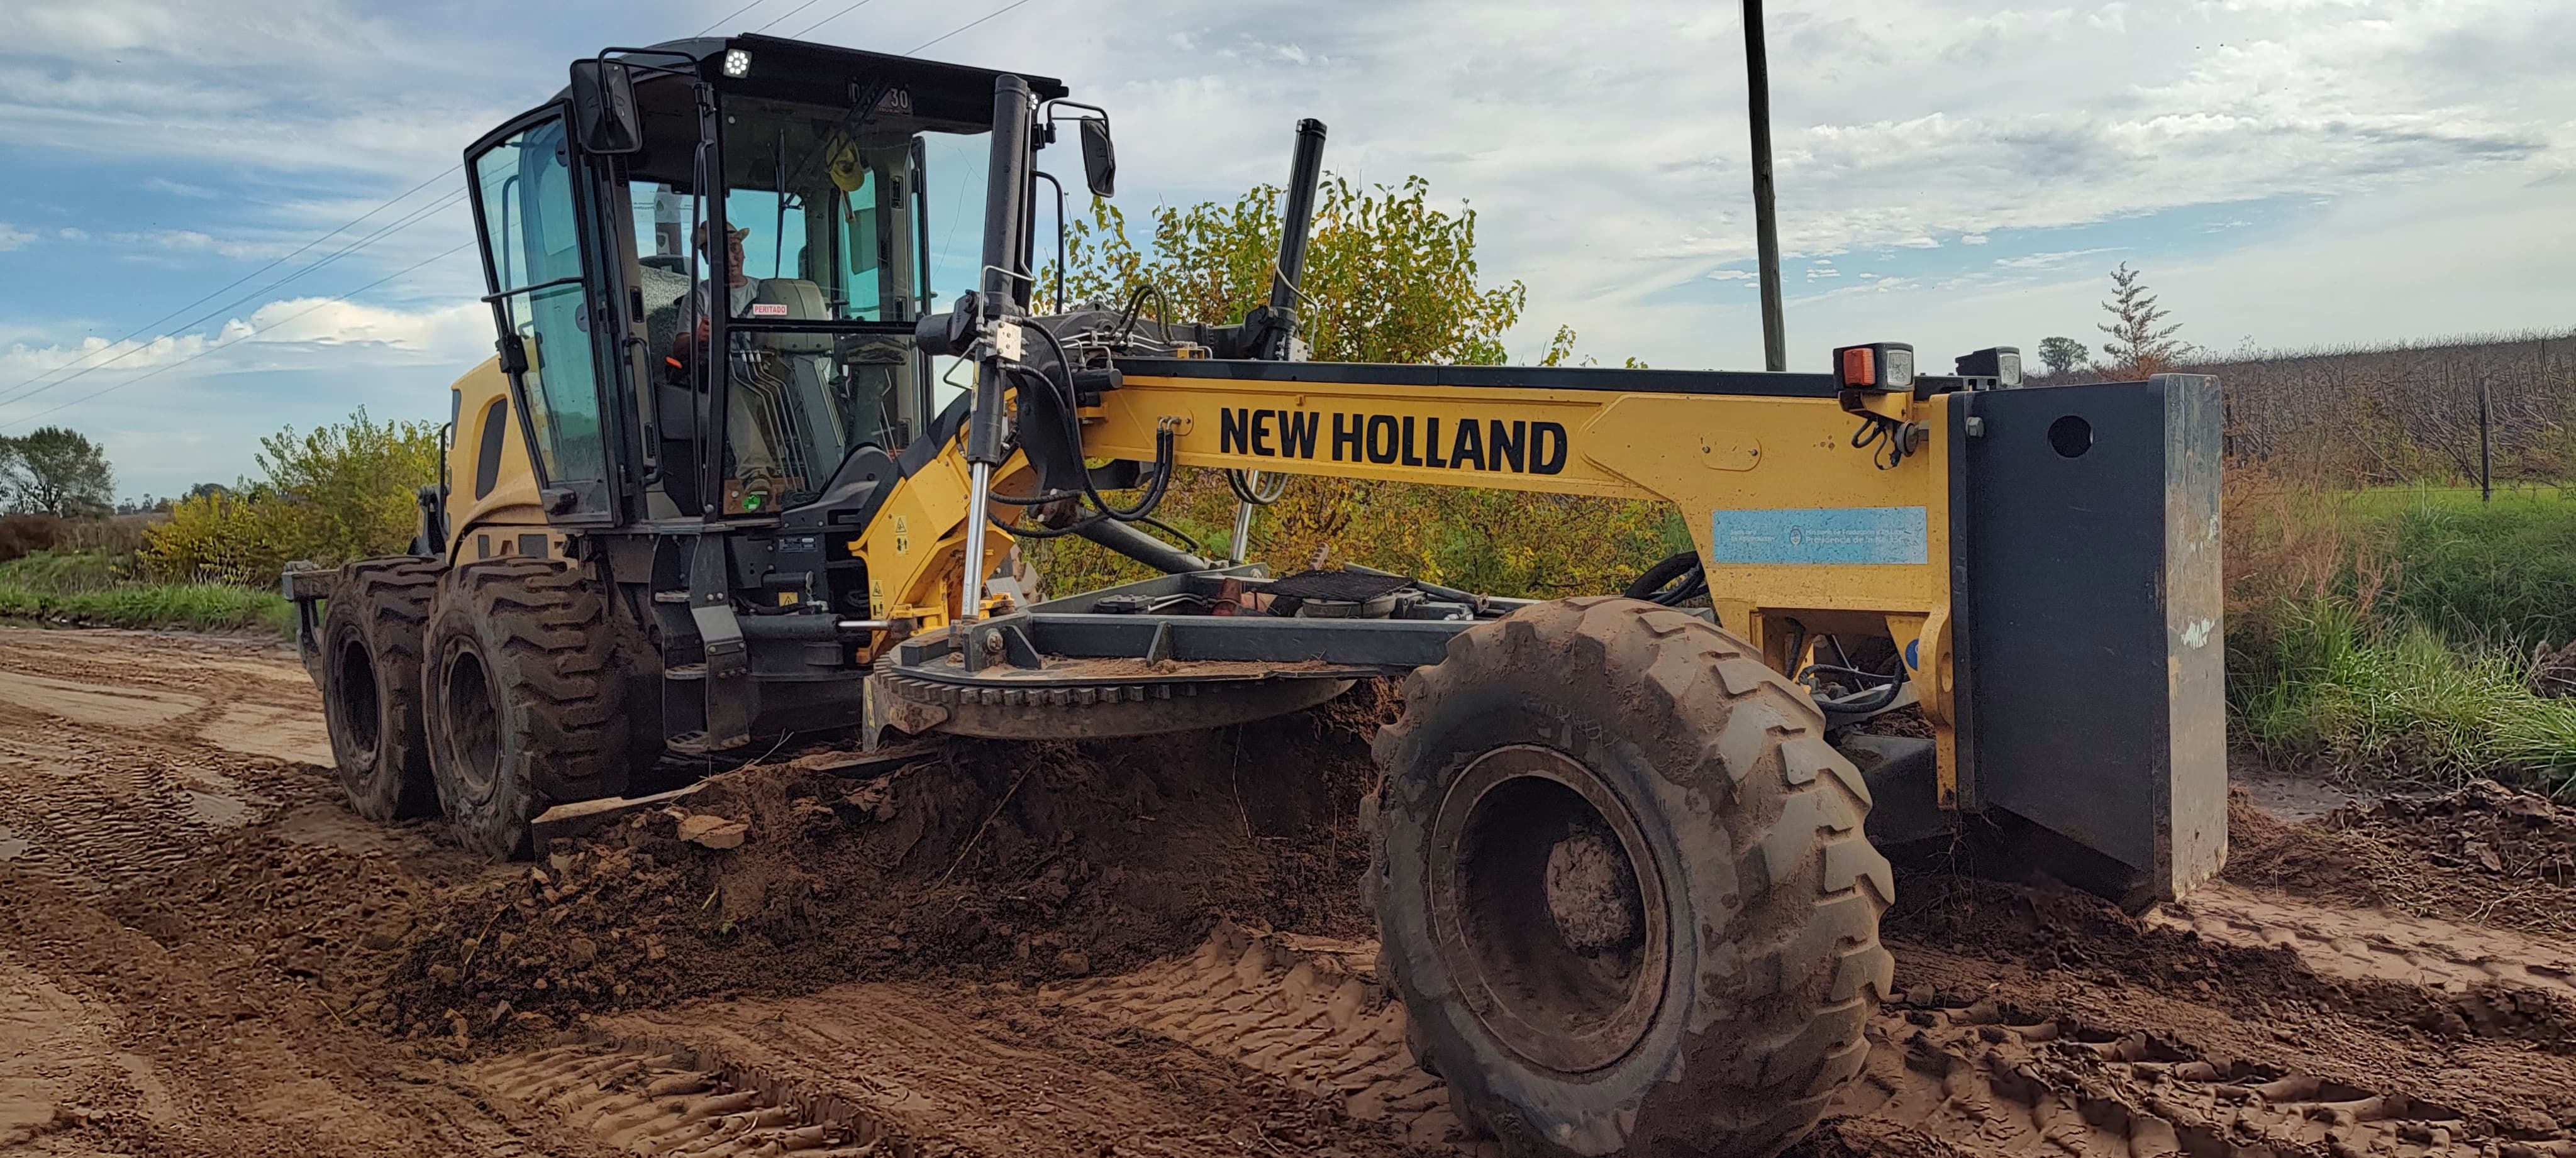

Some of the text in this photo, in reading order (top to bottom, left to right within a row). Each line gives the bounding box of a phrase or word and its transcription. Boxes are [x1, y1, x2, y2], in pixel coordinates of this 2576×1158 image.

[890, 88, 908, 109] 30
[1221, 407, 1568, 475] NEW HOLLAND
